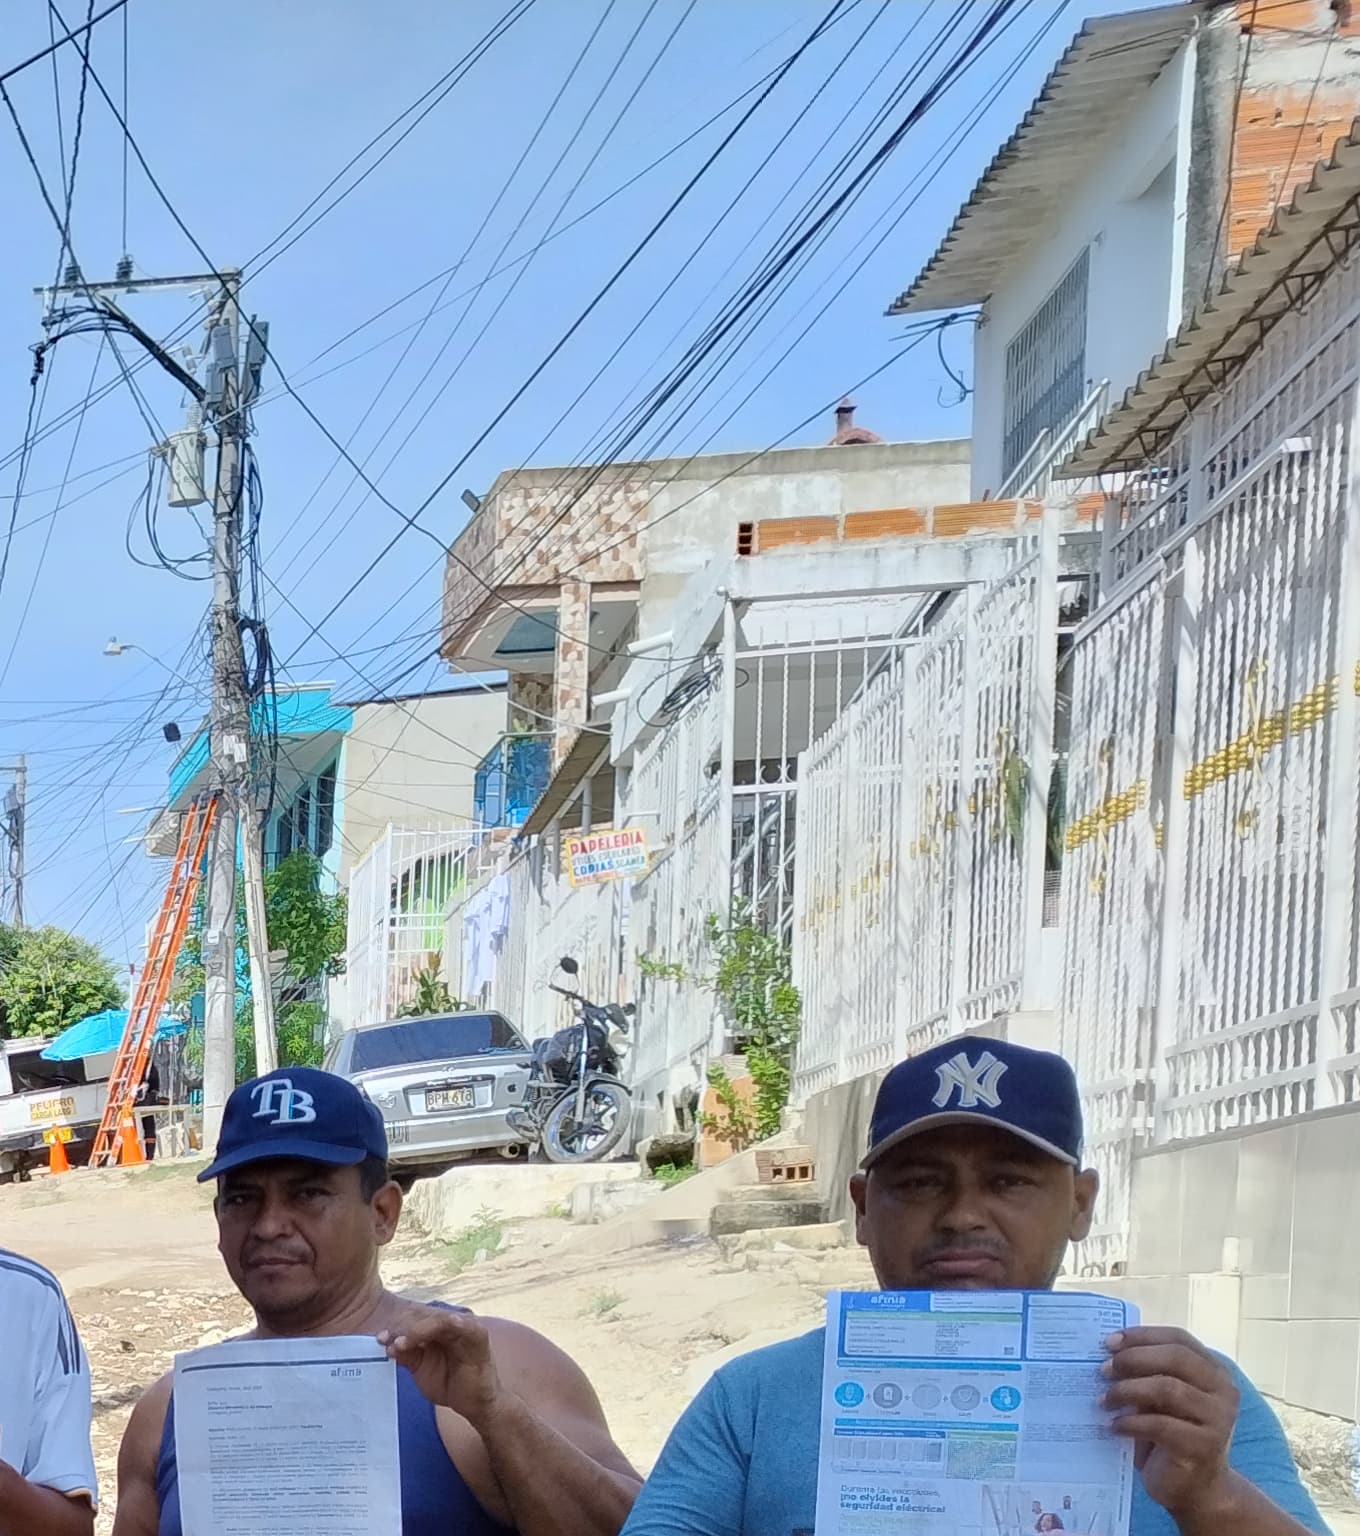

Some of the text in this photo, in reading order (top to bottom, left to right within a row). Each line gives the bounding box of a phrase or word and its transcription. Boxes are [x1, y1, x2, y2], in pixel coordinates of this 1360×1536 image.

[570, 831, 643, 855] PAPELERIA
[573, 859, 614, 876] COPIAS
[250, 1079, 316, 1125] TB
